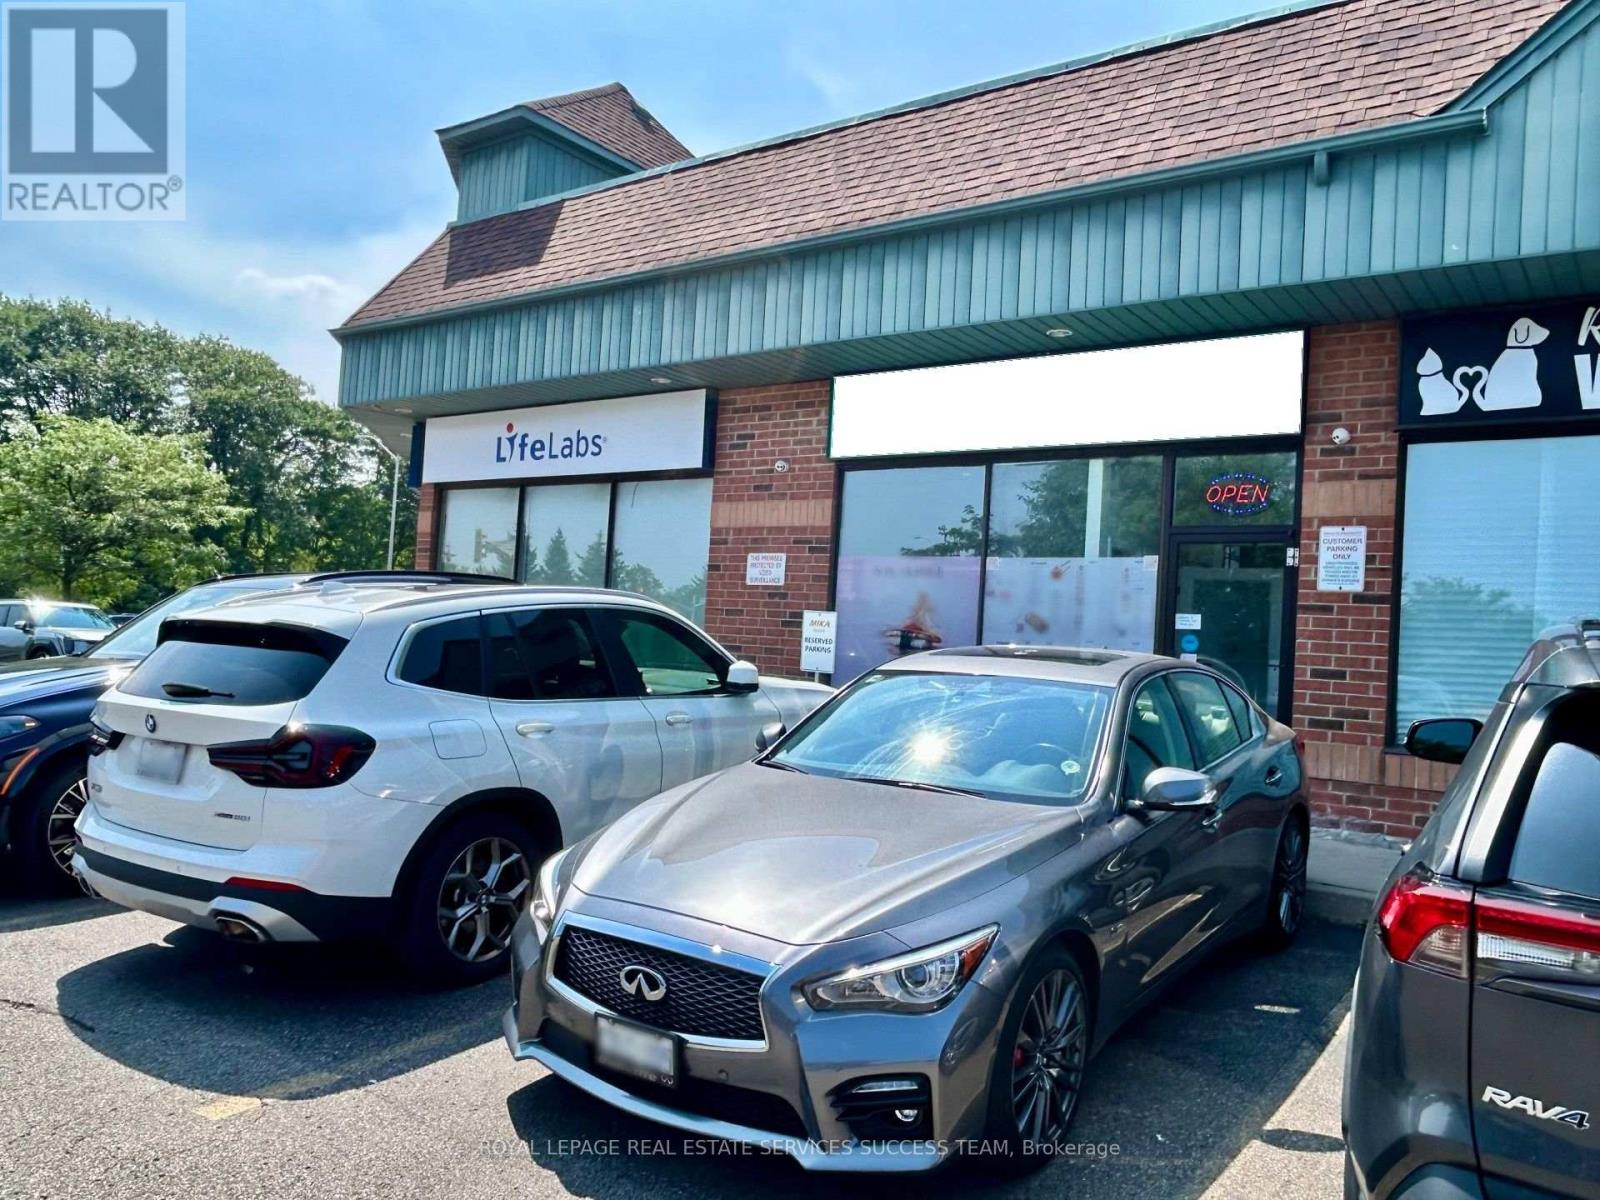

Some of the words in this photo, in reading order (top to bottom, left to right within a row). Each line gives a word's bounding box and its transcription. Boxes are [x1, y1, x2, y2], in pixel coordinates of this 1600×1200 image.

[496, 422, 603, 464] LifeLabs
[1206, 484, 1269, 503] OPEN
[804, 637, 833, 645] RESERVED
[804, 645, 831, 654] PARKING
[1482, 1085, 1590, 1130] RAV4
